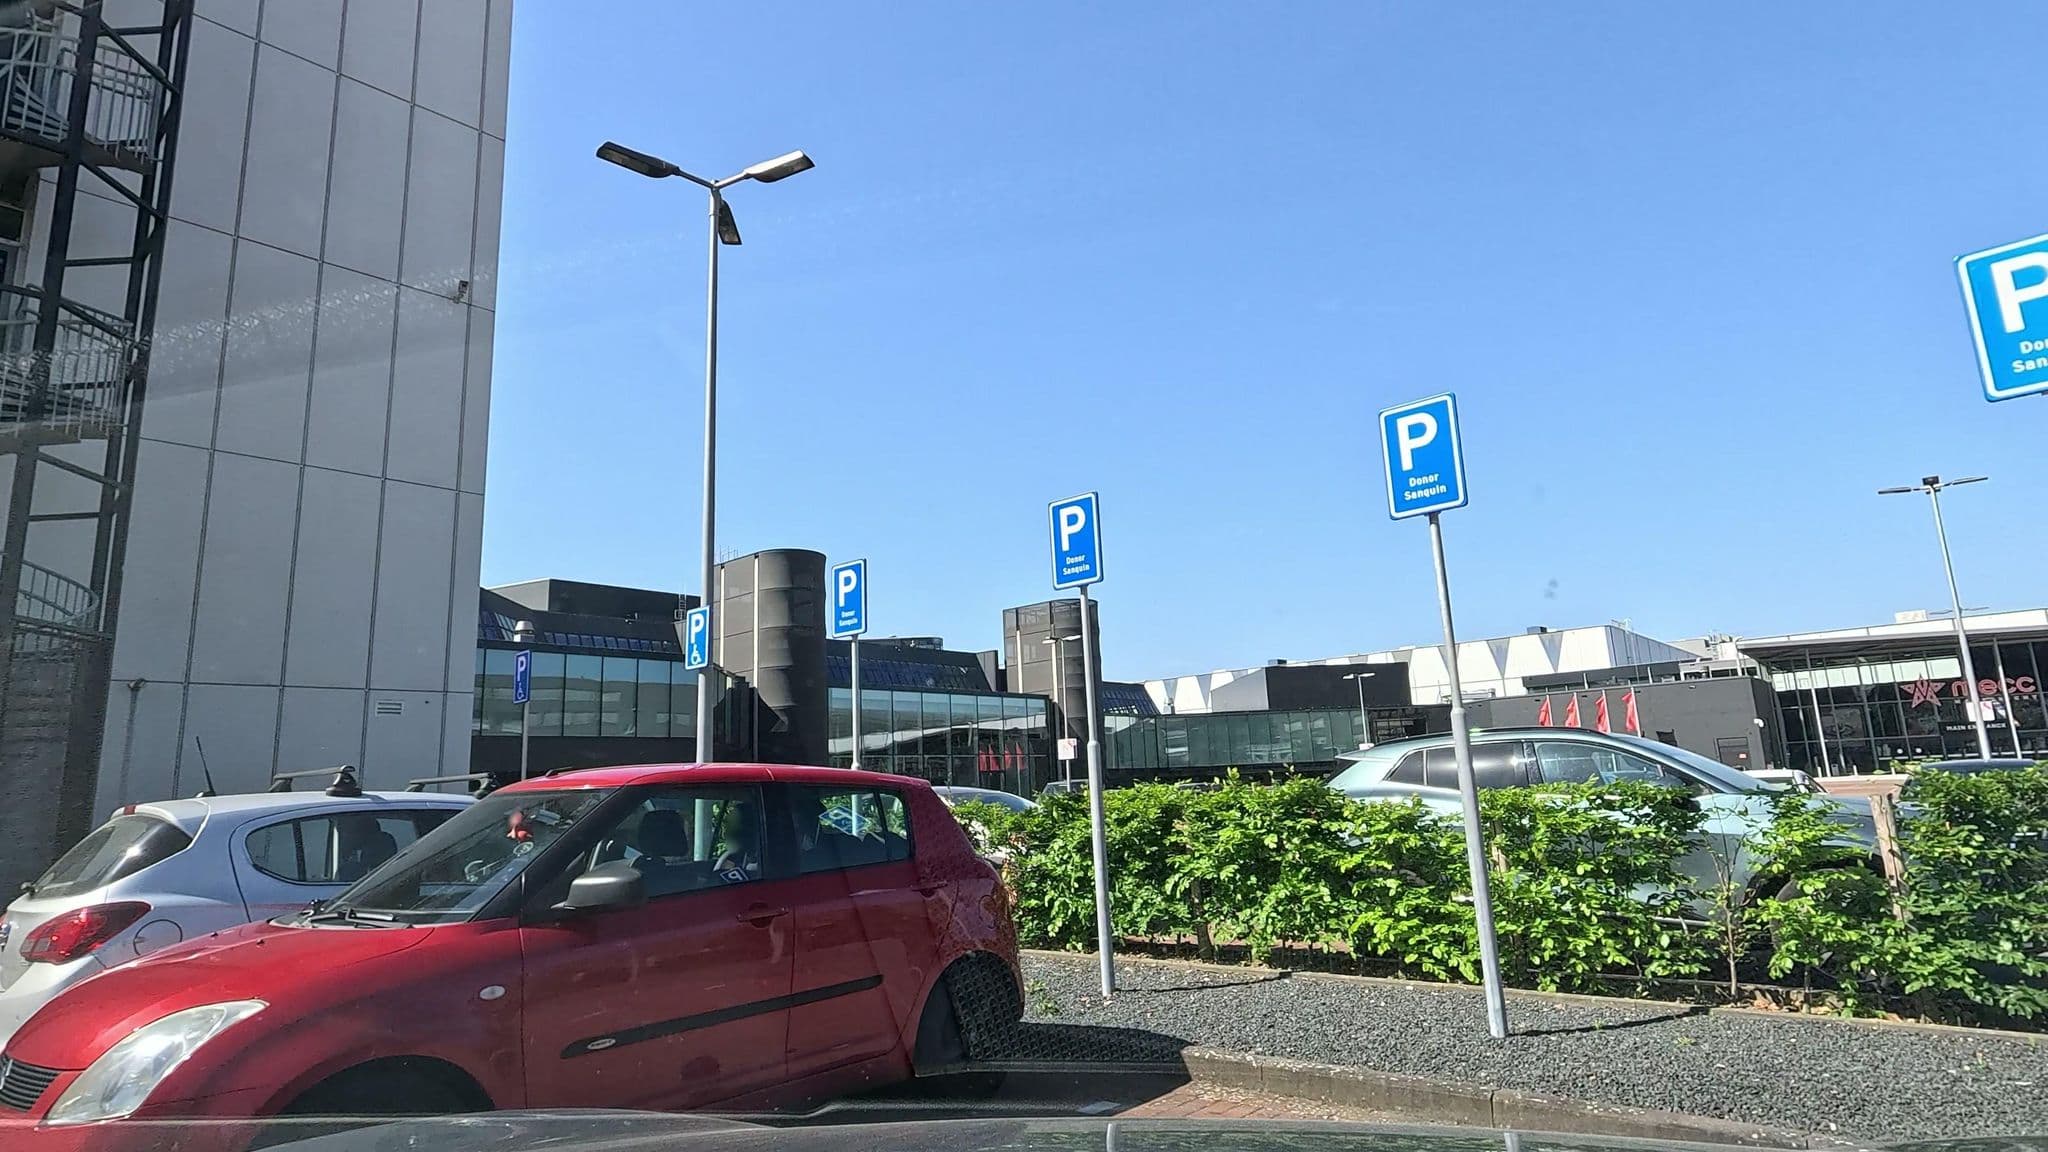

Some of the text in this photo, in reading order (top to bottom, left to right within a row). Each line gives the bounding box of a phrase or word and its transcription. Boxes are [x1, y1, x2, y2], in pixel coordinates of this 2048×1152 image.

[1990, 252, 2048, 333] P
[1396, 412, 1438, 471] P
[1404, 484, 1447, 501] Sanquin
[1409, 473, 1440, 487] Donor
[1060, 505, 1086, 552] P
[839, 569, 857, 608] P
[691, 613, 704, 644] P
[517, 656, 526, 681] P
